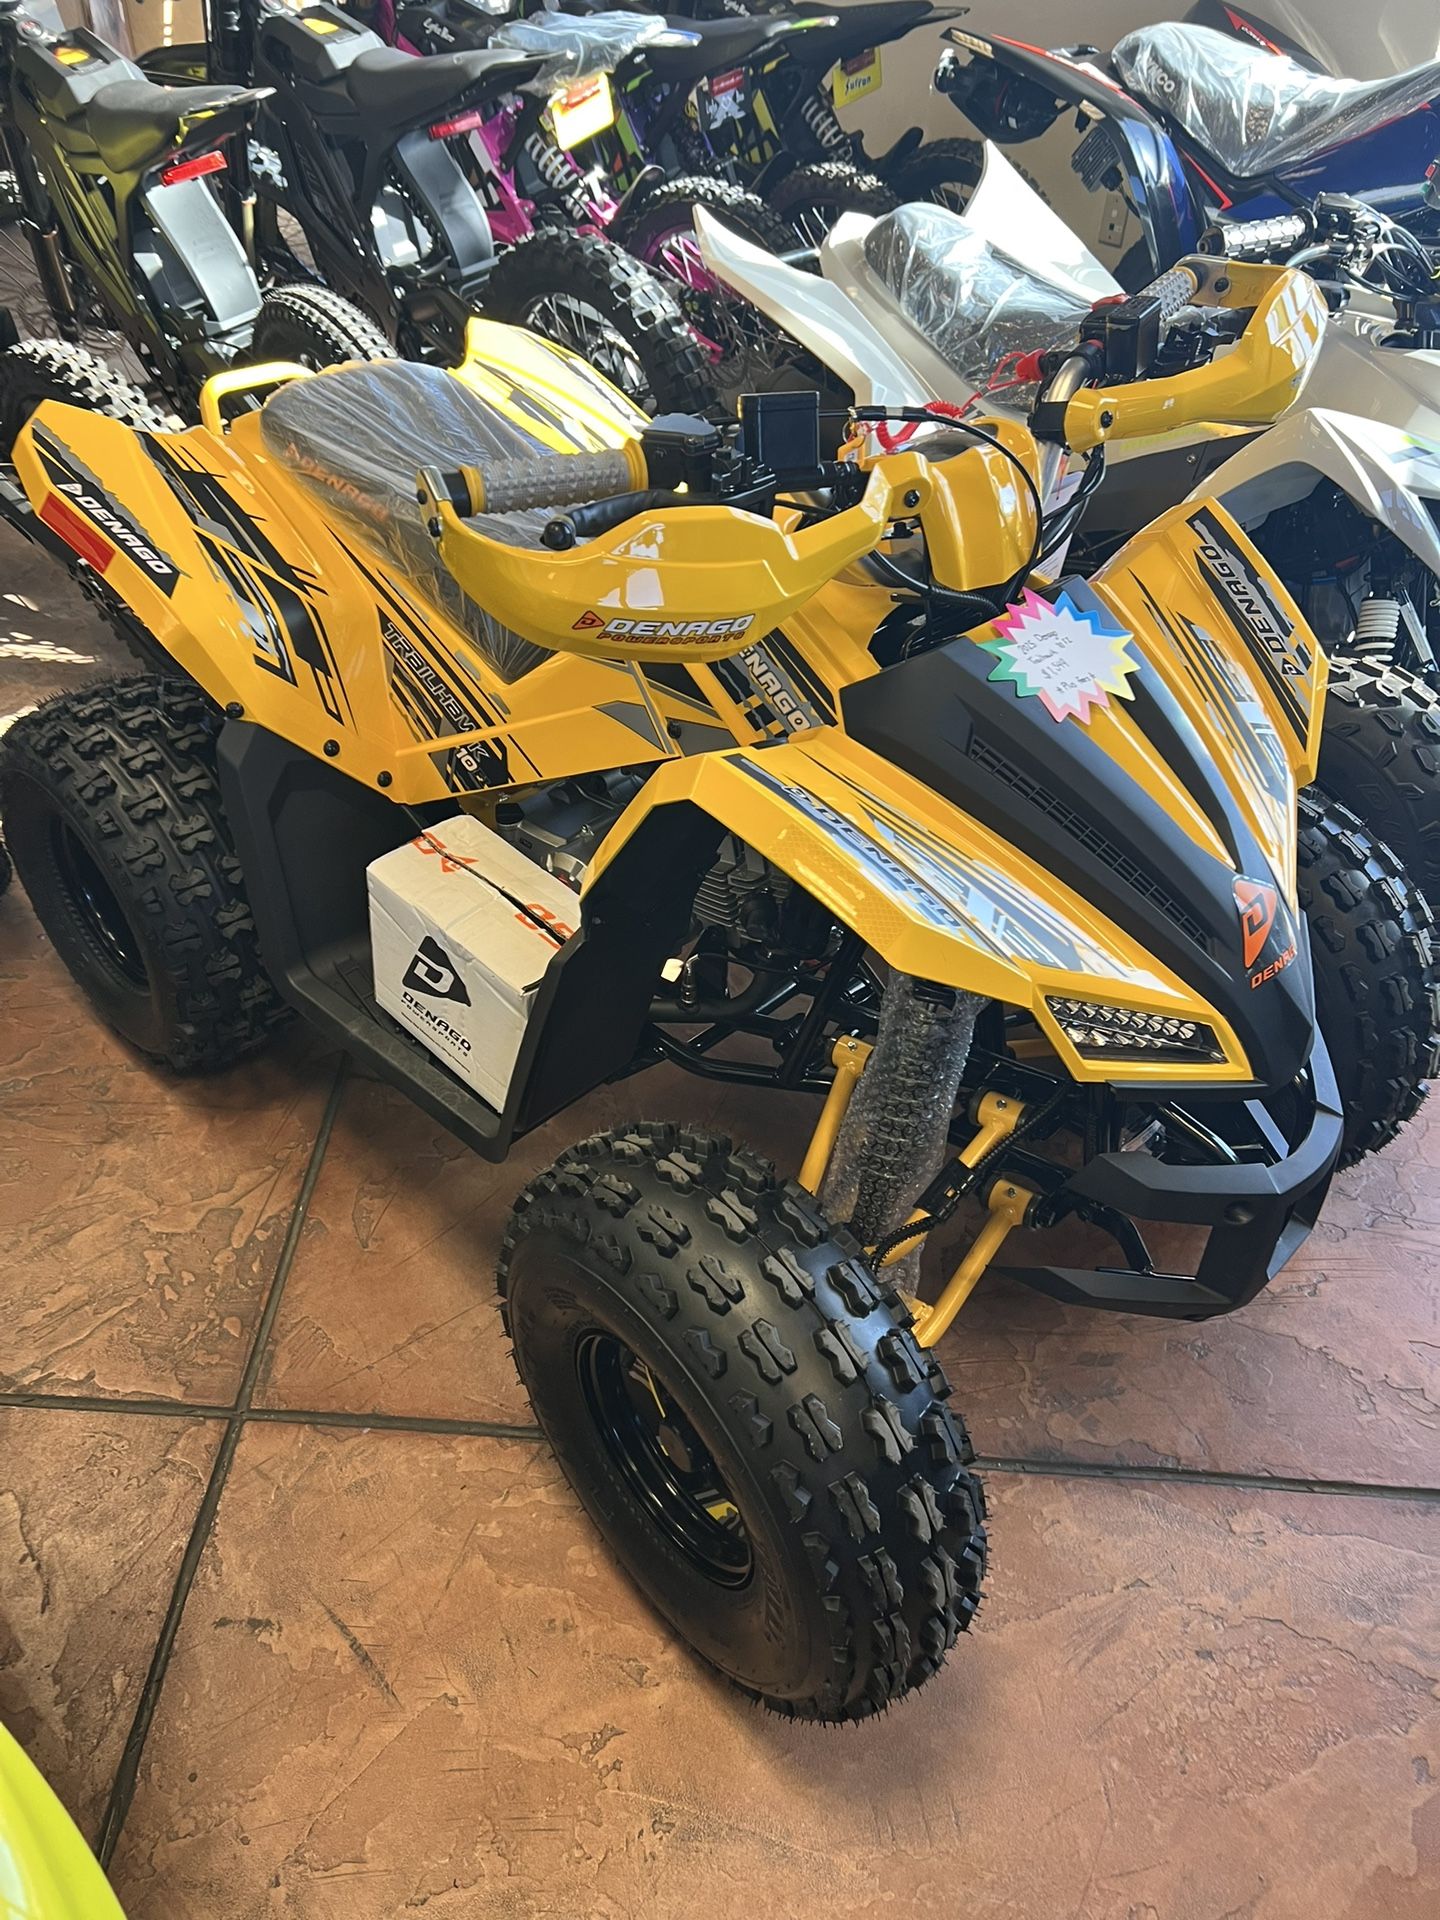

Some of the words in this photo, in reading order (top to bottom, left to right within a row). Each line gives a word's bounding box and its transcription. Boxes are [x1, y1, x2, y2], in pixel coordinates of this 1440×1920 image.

[1147, 57, 1176, 93] YMCO
[302, 456, 389, 523] DENAGO
[75, 496, 173, 574] DENAGO
[604, 613, 756, 637] DENAGO
[1199, 545, 1288, 653] DENAGO
[596, 631, 747, 645] POWERSPORTS
[815, 806, 962, 928] DENAGO
[401, 999, 468, 1057] POWERSPORTS
[402, 991, 472, 1052] DENAGO
